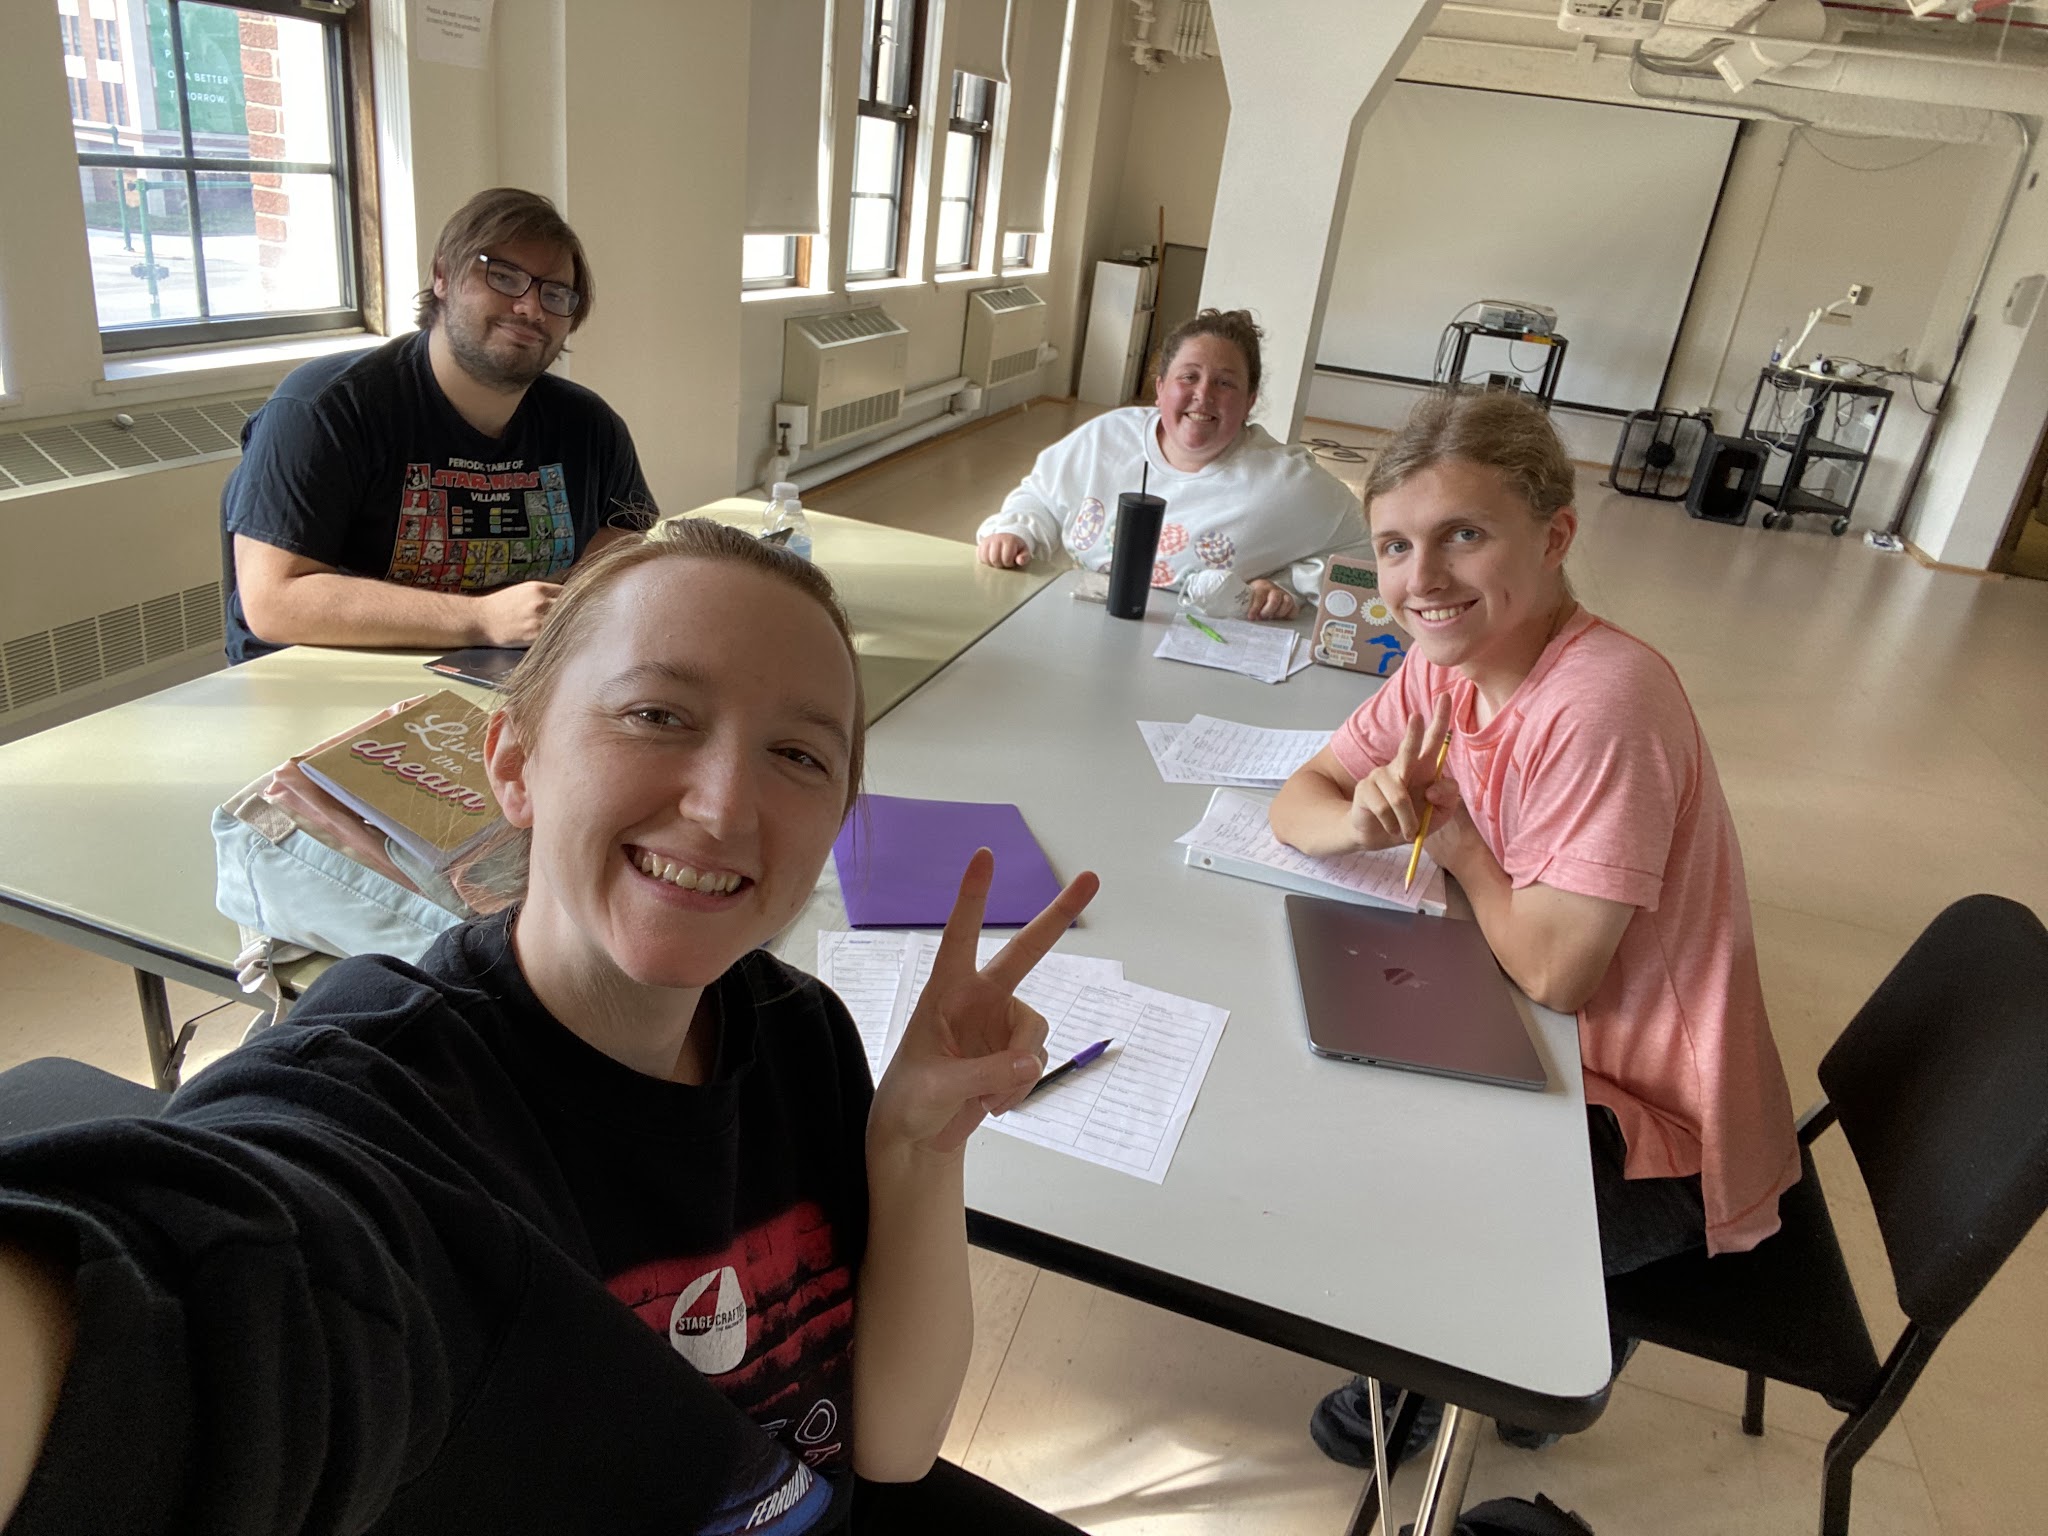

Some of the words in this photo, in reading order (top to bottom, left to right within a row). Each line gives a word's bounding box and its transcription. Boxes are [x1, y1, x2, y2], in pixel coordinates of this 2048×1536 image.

[164, 48, 190, 60] PT
[194, 72, 229, 85] BETTER
[169, 90, 227, 104] TORROW.
[486, 461, 511, 472] TABLE
[512, 460, 524, 469] OF
[432, 469, 491, 490] STAR
[489, 471, 540, 490] WARS
[471, 492, 510, 502] VILLAINS
[430, 754, 463, 775] the
[350, 738, 486, 816] dream
